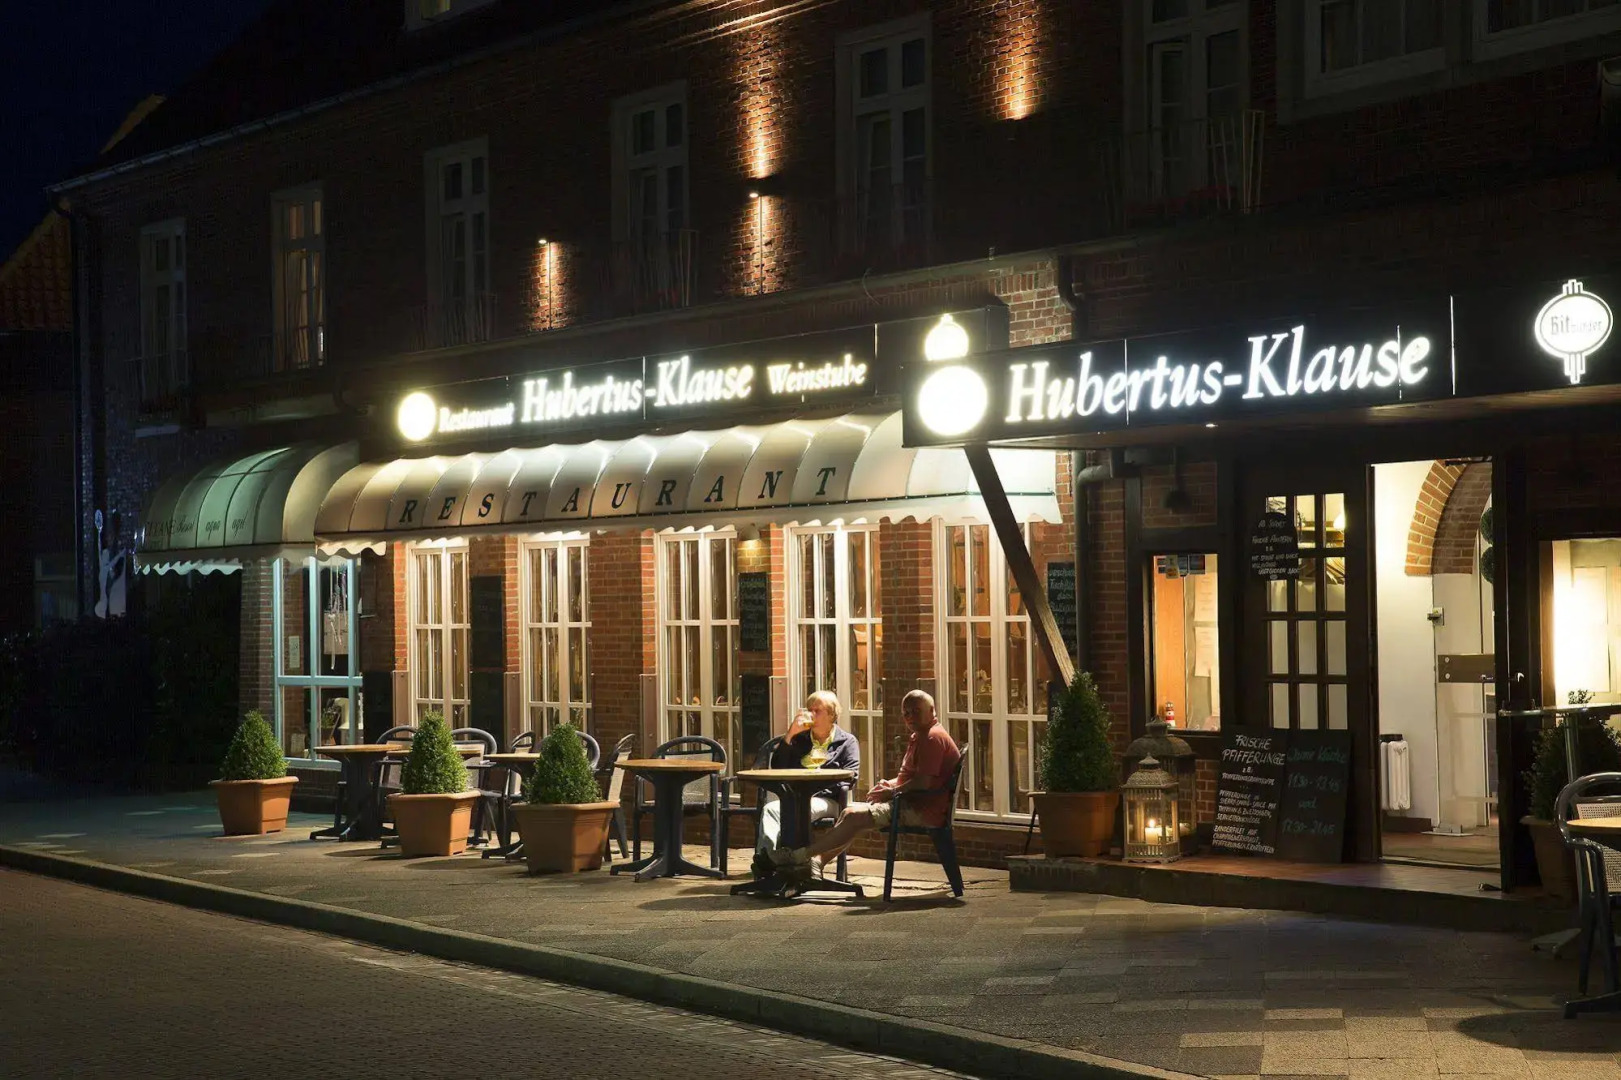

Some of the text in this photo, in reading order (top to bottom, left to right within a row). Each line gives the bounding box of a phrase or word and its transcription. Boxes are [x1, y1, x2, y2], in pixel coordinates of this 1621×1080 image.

[521, 355, 754, 422] Hubertus-Klause
[767, 353, 867, 394] Weinstube
[1005, 324, 1431, 423] Hubertus-Klause
[398, 466, 836, 523] RESTAURANT
[1235, 734, 1272, 750] FRISCHE
